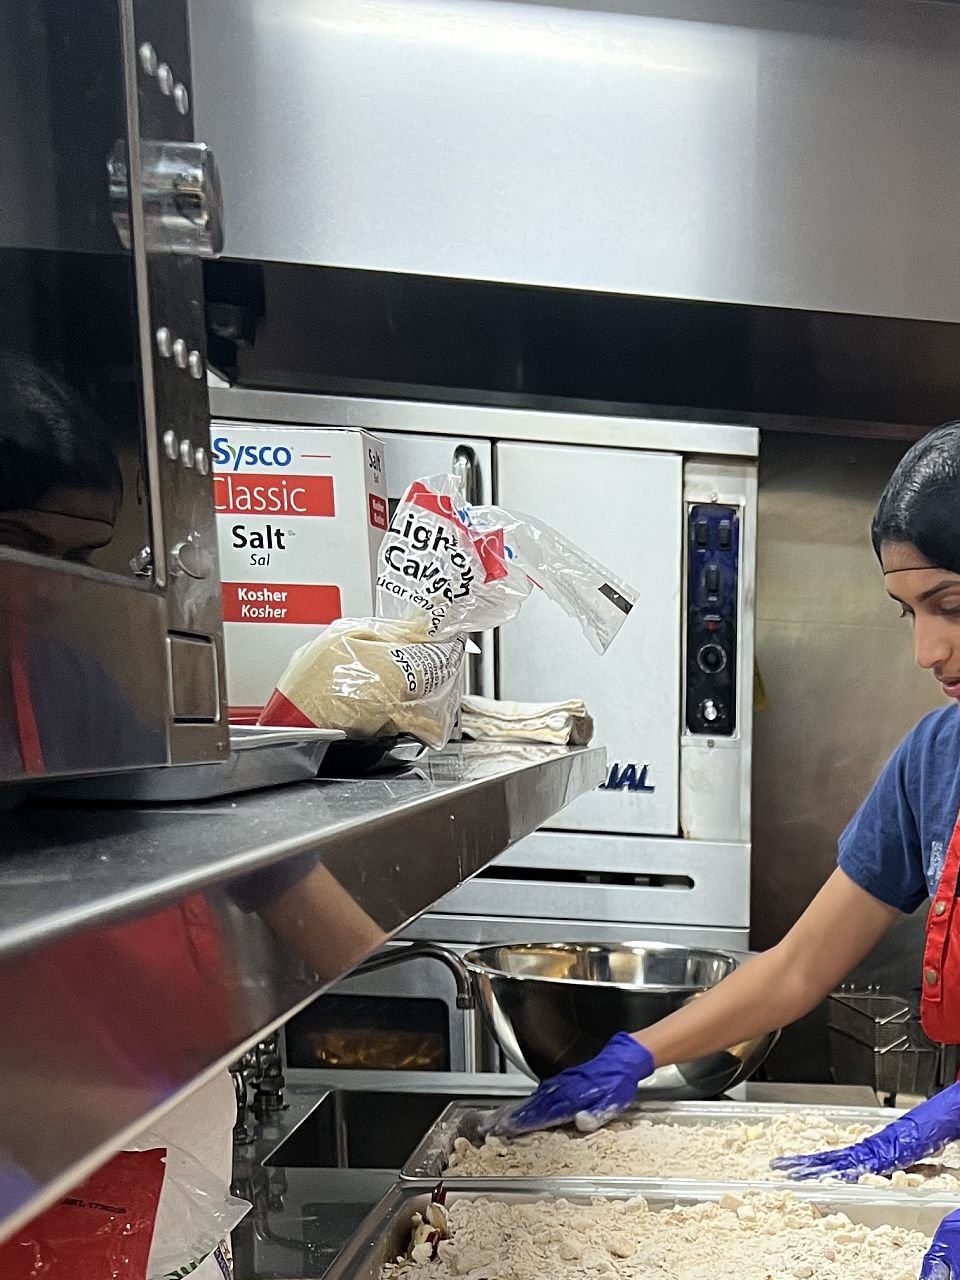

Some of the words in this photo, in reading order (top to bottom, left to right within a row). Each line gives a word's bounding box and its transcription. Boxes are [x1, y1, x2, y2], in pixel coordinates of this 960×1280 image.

[231, 523, 287, 550] Salt
[249, 553, 271, 566] Sal
[237, 587, 288, 602] Kosher
[240, 604, 288, 618] Kosher
